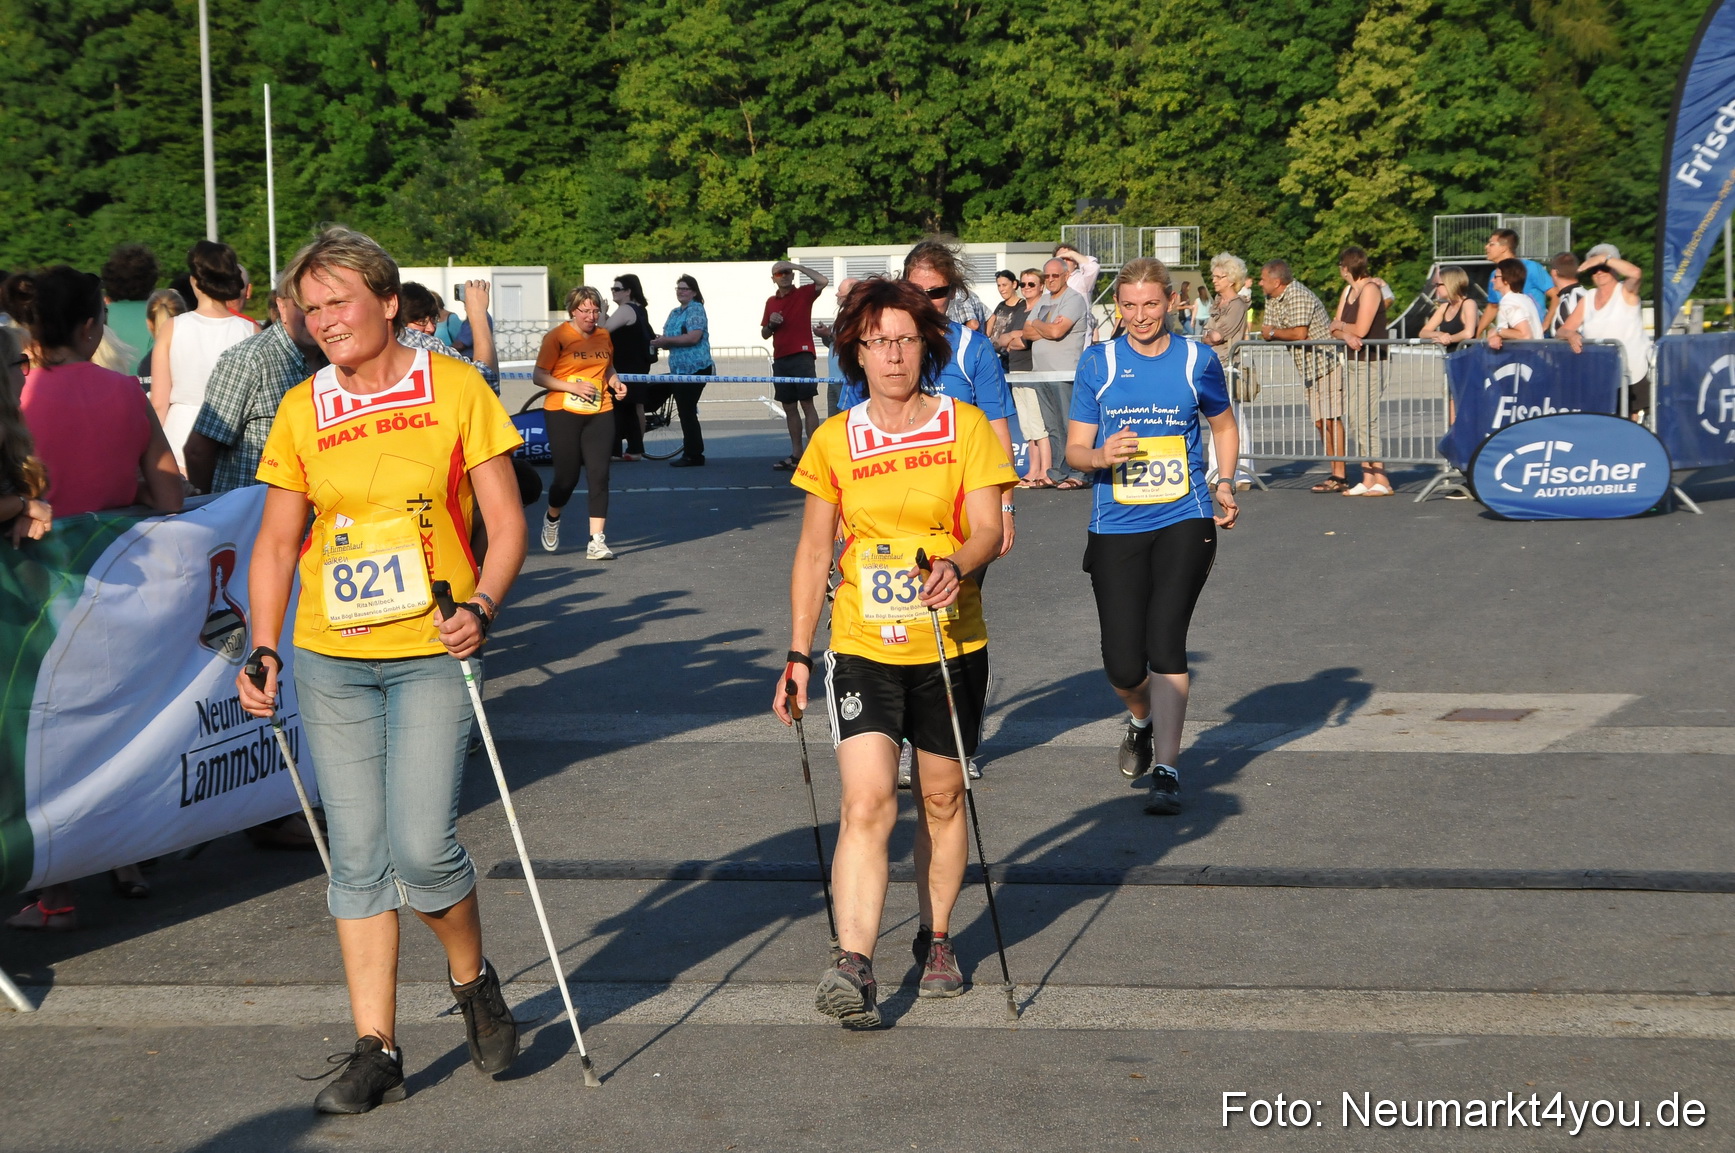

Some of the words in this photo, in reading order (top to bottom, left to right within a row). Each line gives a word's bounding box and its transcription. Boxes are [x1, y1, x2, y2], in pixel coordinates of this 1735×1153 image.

[1105, 405, 1150, 418] Irgendwann
[1118, 416, 1142, 428] jeder
[317, 423, 369, 452] MAX
[376, 412, 439, 435] BÖGL
[852, 458, 898, 481] MAX
[904, 450, 958, 470] BÖGL
[1115, 459, 1184, 488] 1293
[1521, 458, 1647, 485] Fischer
[1533, 482, 1637, 498] AUTOMOBILE
[332, 554, 405, 602] 821
[871, 569, 926, 604] 83
[341, 612, 354, 620] Bögl
[354, 608, 383, 618] Bauservice
[888, 611, 914, 619] Bauservice
[219, 632, 244, 654] 1628
